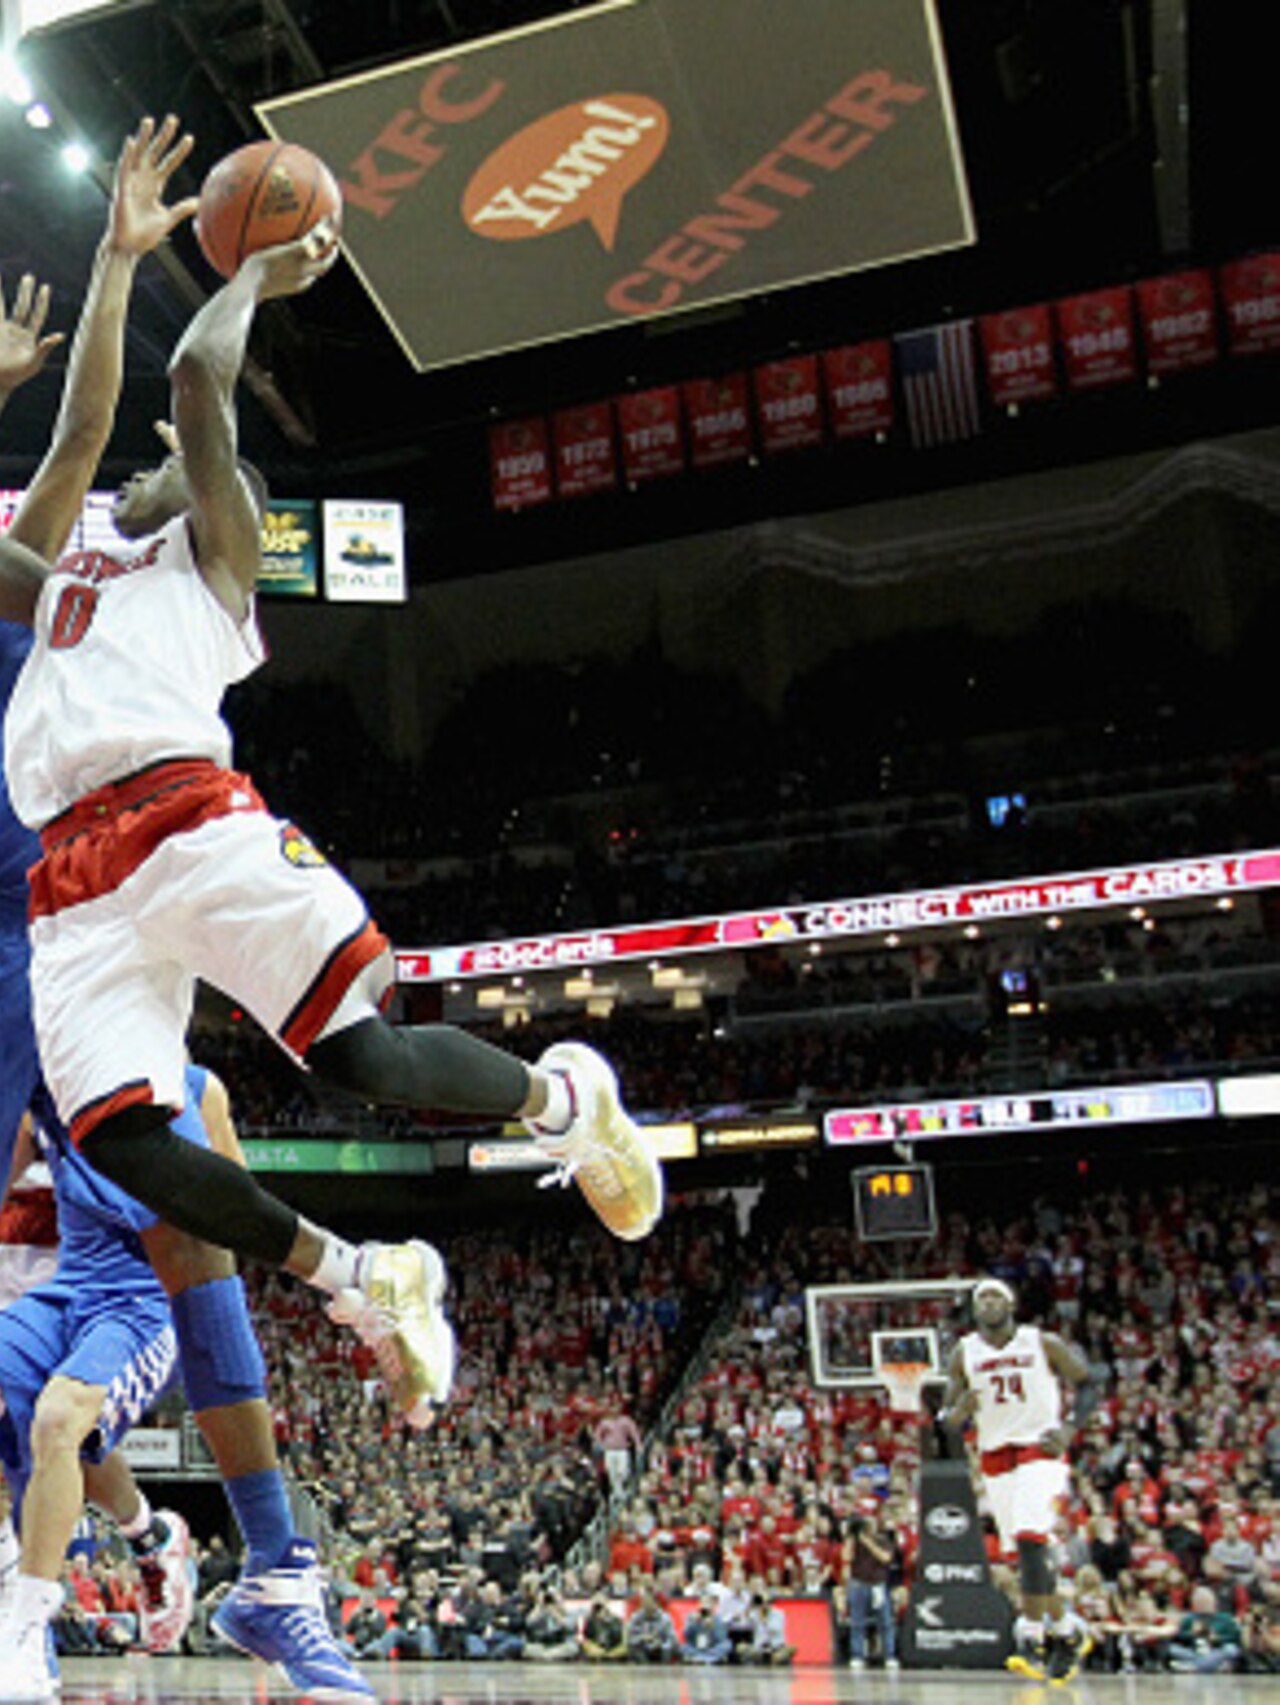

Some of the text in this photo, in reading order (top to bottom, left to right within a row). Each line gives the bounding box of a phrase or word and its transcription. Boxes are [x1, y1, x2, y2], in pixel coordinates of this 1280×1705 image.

[340, 64, 506, 218] KFC
[471, 102, 657, 230] Yum!
[605, 67, 928, 315] CENTER
[49, 583, 101, 649] 0
[806, 896, 957, 933] CONNECT
[969, 889, 1039, 914] WITH
[1104, 866, 1223, 898] CARDS
[989, 1372, 1027, 1404] 24
